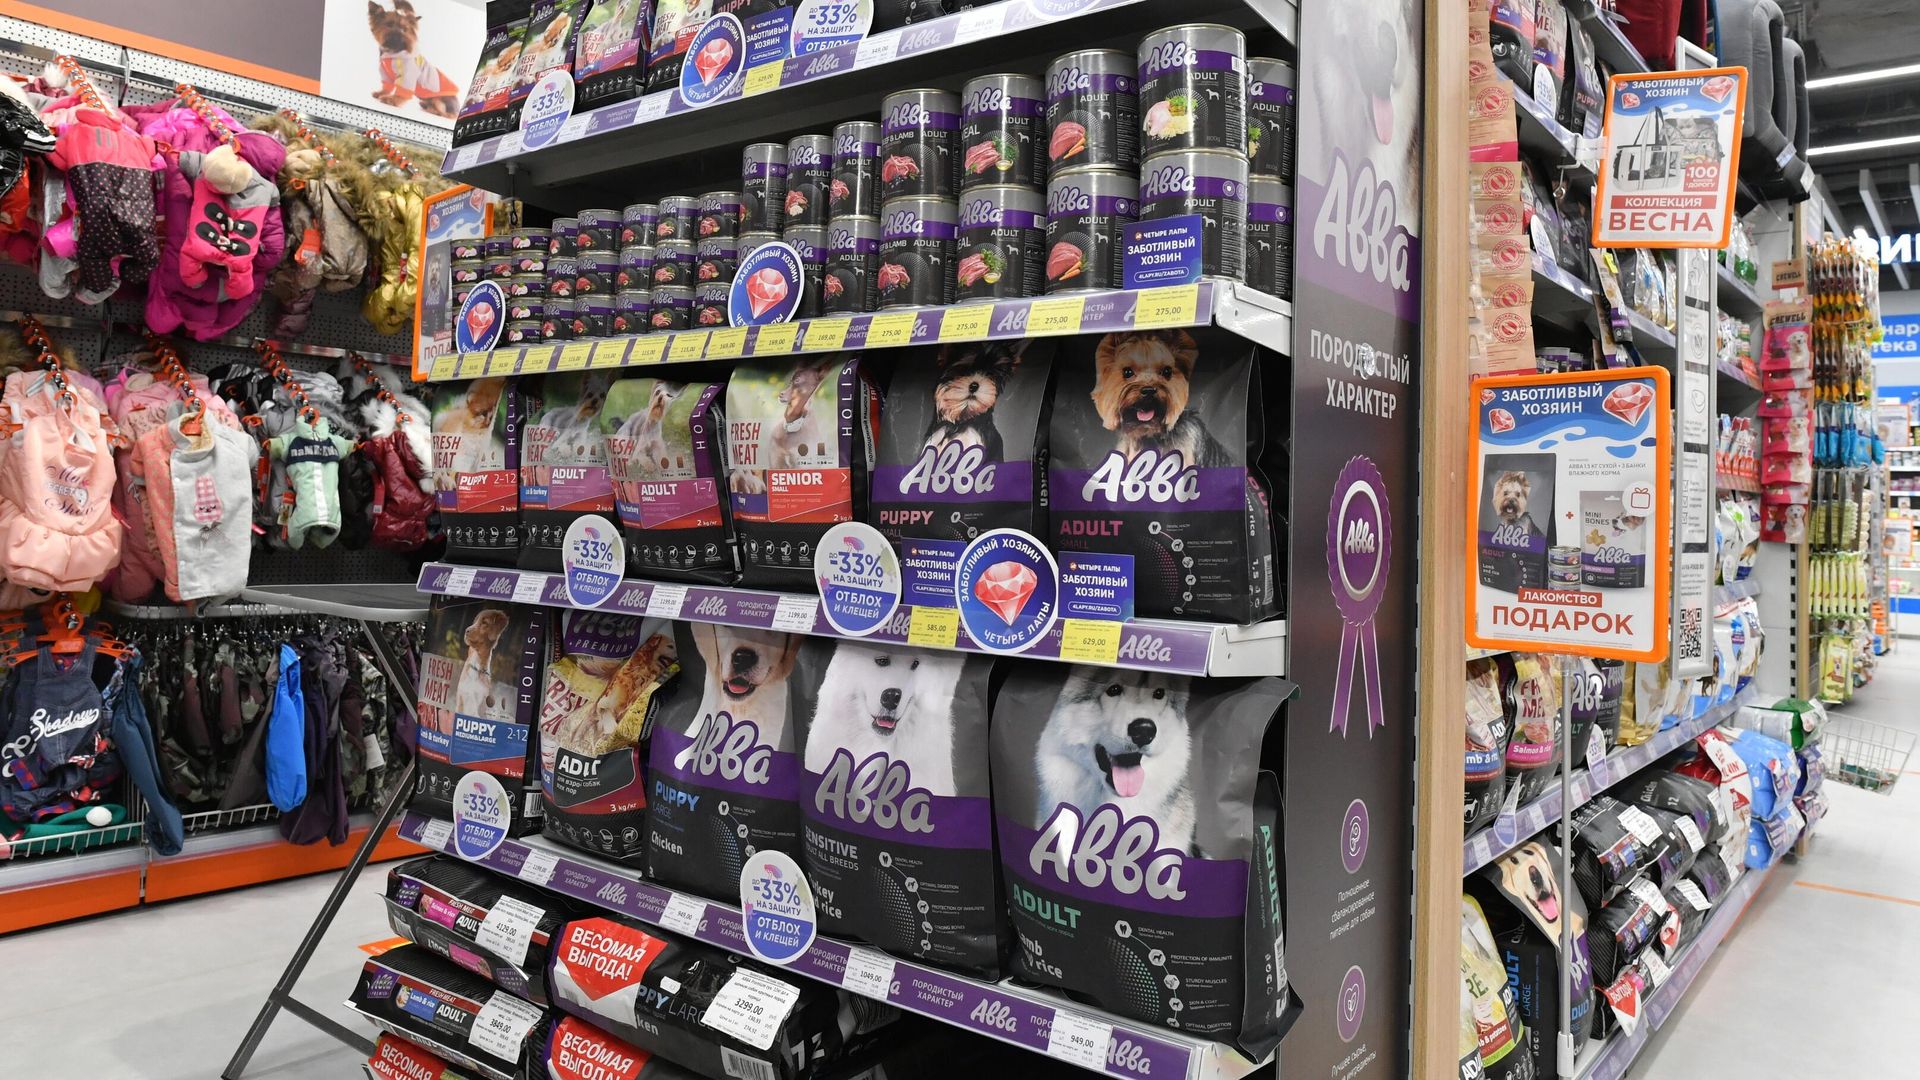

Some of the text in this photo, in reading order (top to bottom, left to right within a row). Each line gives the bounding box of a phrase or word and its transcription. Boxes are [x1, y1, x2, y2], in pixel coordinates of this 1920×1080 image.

[808, 4, 857, 26] -33%
[747, 23, 789, 43] ЗАБОТЛИВЫЙ
[820, 25, 855, 35] ЗАЩИТУ
[686, 19, 740, 67] ЗАБОТЛИВЫЙ ХОЗЯИН
[754, 36, 781, 50] ХОЗЯИН
[712, 71, 734, 95] ЛАПЫ
[1189, 72, 1219, 82] ADULT
[1631, 77, 1705, 90] ЗАБОТЛИВЫЙ
[1079, 93, 1110, 103] ADULT
[1645, 87, 1689, 98] ХОЗЯИН
[1252, 103, 1281, 113] ADULT
[1002, 117, 1030, 126] ADULT
[921, 130, 948, 139] ADULT
[846, 158, 872, 166] ADULT
[805, 170, 830, 178] ADULT
[1184, 198, 1216, 207] ADULT
[1625, 197, 1702, 208] КОЛЛЕКЦИЯ
[1077, 216, 1109, 225] ADULT
[1608, 211, 1714, 232] ВЕСНА
[990, 228, 1019, 238] ADULT
[1143, 227, 1188, 239] ЧЕТЫРЕ ЛАПЫ
[913, 239, 941, 248] ADULT
[1127, 236, 1196, 255] ЗАБОТЛИВЫЙ
[839, 254, 865, 262] ADULT
[1140, 252, 1182, 266] ХОЗЯИН
[736, 248, 799, 285] ЗАБОТЛИВЫЙ ХОЗЯИН
[1155, 306, 1182, 316] 275,00
[956, 321, 978, 331] 275,00
[1045, 315, 1068, 325] 275,00
[1326, 377, 1397, 420] ХАРАКТЕР
[1501, 382, 1604, 402] ЗАБОТЛИВЫЙ
[1521, 401, 1583, 416] ХОЗЯИН
[731, 421, 761, 441] FRESH
[460, 474, 488, 486] PUPPY
[551, 468, 587, 480] ADULT
[771, 472, 823, 486] SENIOR
[641, 483, 677, 496] ADULT
[879, 509, 934, 525] PUPPY
[1584, 517, 1611, 526] BONES
[1059, 519, 1124, 537] ADULT
[573, 539, 614, 562] -33%
[917, 549, 938, 557] ЧЕТЫРЕ
[585, 560, 613, 571] ЗАЩИТУ
[829, 551, 884, 578] -33%
[960, 538, 1042, 602] ЗАБОТЛИВЫЙ ХОЗЯИН
[1078, 563, 1121, 573] ЧЕТЫРЕ ЛАПЫ
[833, 574, 884, 588] НА ЗАЩИТУ
[916, 570, 951, 581] ХОЗЯИН
[1062, 573, 1128, 588] ЗАБОТЛИВЫЙ
[579, 584, 606, 596] КЛЕЩЕЙ
[1075, 587, 1115, 599] ХОЗЯИН
[1523, 591, 1598, 605] ЛАКОМСТВО
[739, 609, 769, 618] ХАРАКТЕР
[841, 604, 879, 619] КЛЕЩЕЙ
[984, 601, 1050, 645] ЧЕТЫРЕ ЛАПЫ
[1492, 605, 1634, 636] ПОДАРОК
[1082, 637, 1106, 646] 629,00
[29, 707, 100, 741] Shadow
[456, 718, 497, 737] PUPPY
[1512, 744, 1538, 755] Salmon
[655, 779, 700, 812] PUPPY
[463, 793, 500, 816] -33%
[474, 811, 499, 824] ЗАЩИТУ
[651, 830, 684, 857] Chicken
[829, 855, 859, 871] BREEDS
[753, 878, 801, 906] -33%
[756, 900, 801, 916] НА ЗАЩИТУ
[821, 900, 843, 919] rice
[1013, 883, 1082, 930] ADULT
[1331, 891, 1375, 923] сбалансированное
[496, 922, 517, 936] 4129,00
[1329, 921, 1350, 941] питание
[1350, 916, 1359, 929] для
[569, 926, 647, 964] ВЕСОМАЯ
[763, 931, 799, 948] КЛЕЩЕЙ
[567, 948, 633, 981] ВЫГОДА!
[1170, 954, 1201, 962] PROTECTION
[860, 970, 883, 984] 1049,00
[1035, 959, 1063, 980] rice
[912, 979, 964, 1002] ПОРОДИСТЫЙ
[734, 998, 764, 1016] 3299,00
[916, 992, 955, 1009] ХАРАКТЕР
[1522, 983, 1533, 1018] LARGE
[436, 1004, 468, 1023] ADULT
[490, 1018, 512, 1034] 3849,00
[1070, 1034, 1094, 1049] 949,00
[559, 1031, 634, 1074] ВЕСОМАЯ
